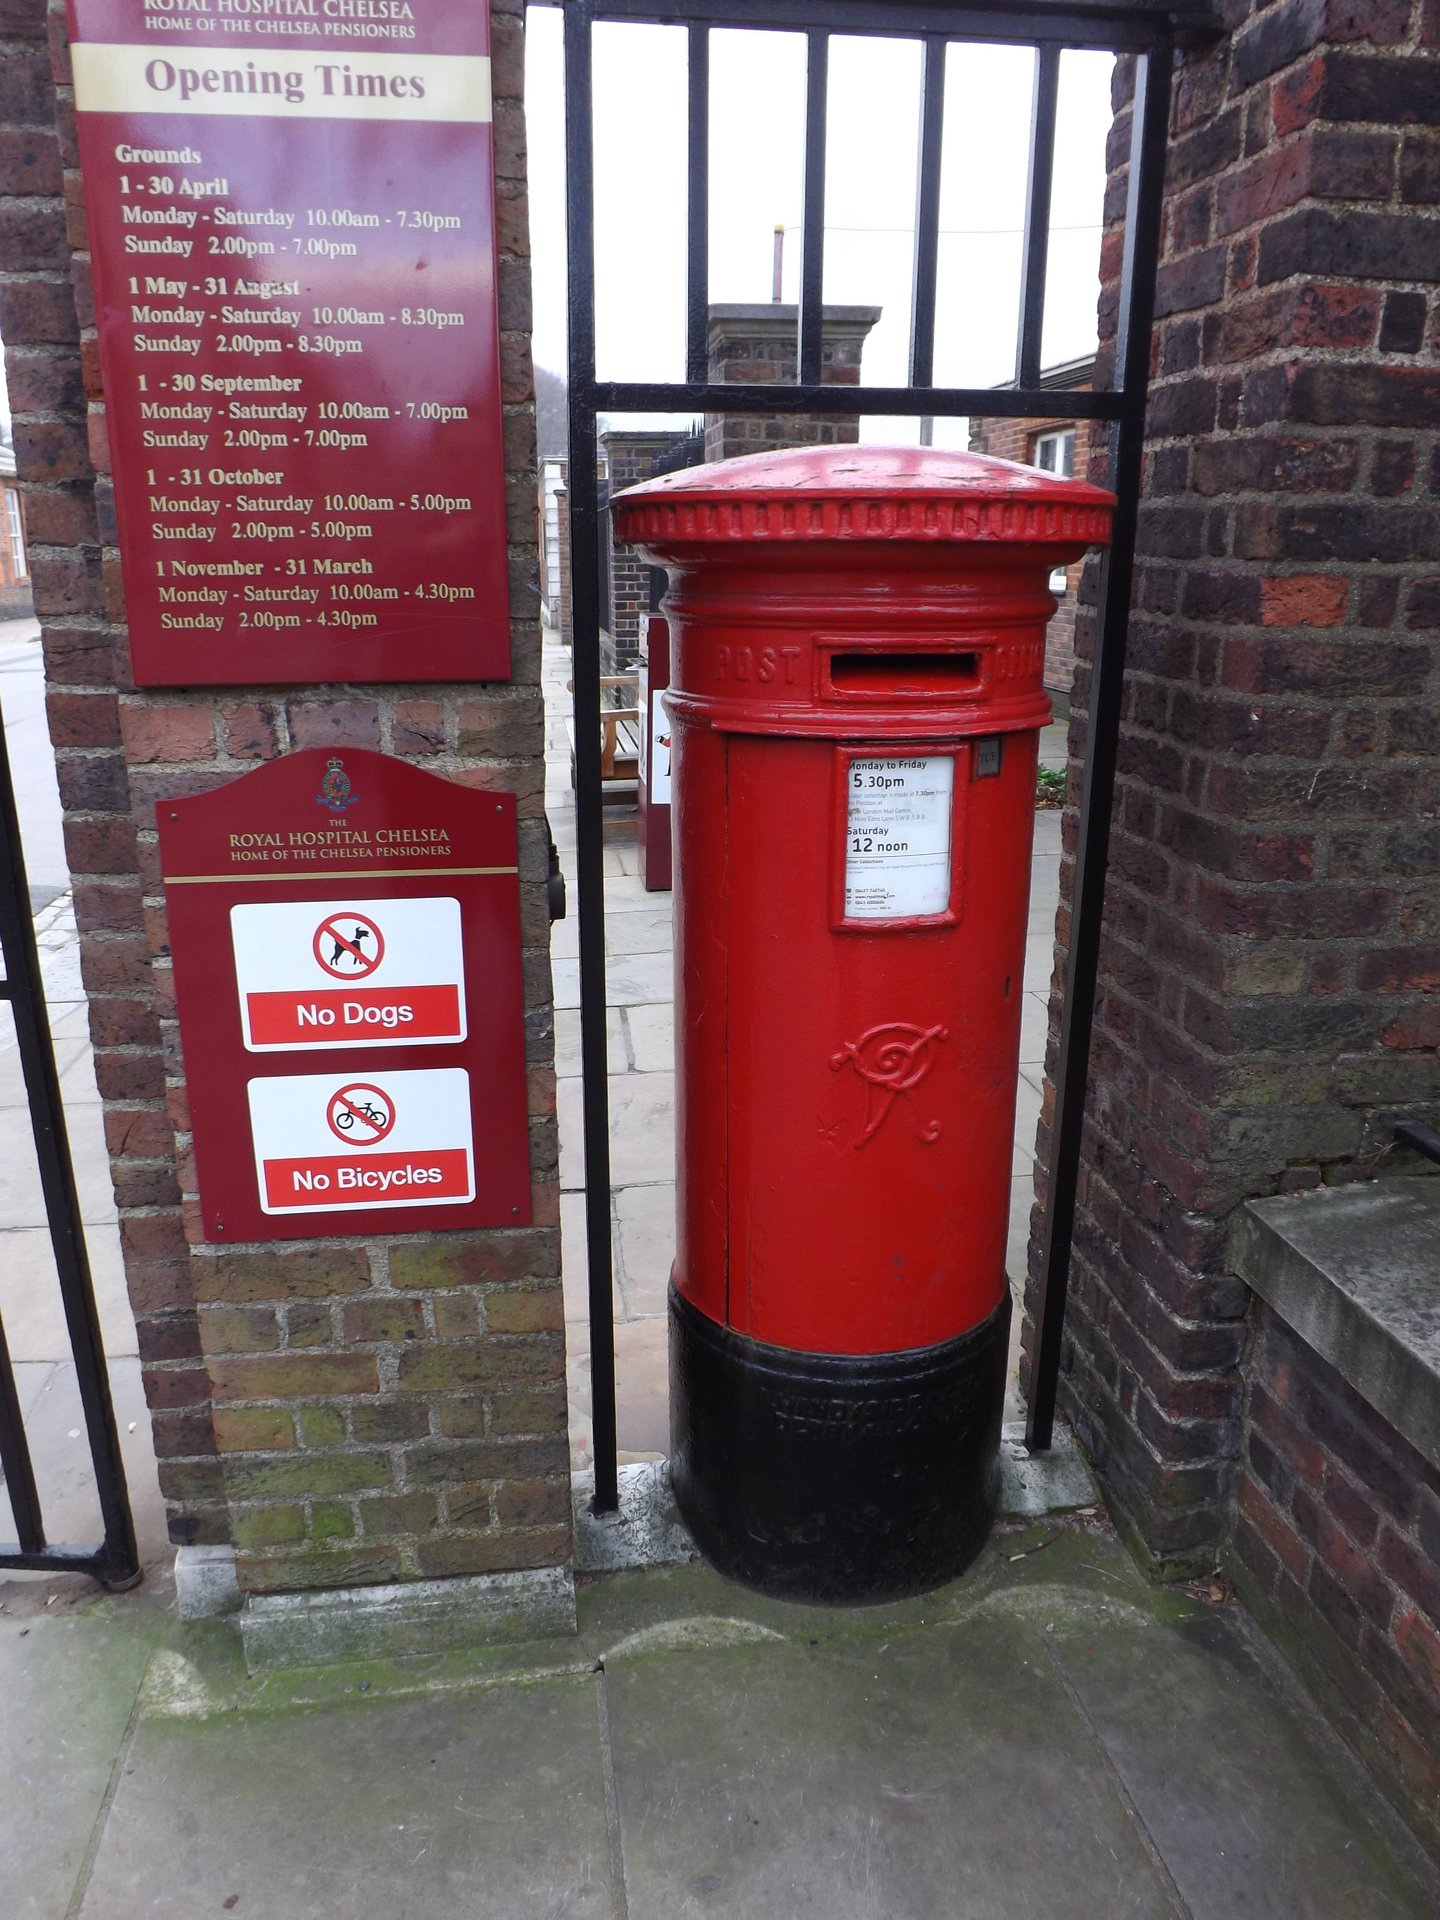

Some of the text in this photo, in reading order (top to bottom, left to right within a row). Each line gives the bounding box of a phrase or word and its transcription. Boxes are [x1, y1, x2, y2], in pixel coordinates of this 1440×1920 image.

[218, 0, 318, 16] HOSPITAL
[323, 0, 414, 19] CHELSEA
[145, 16, 416, 39] HOME OF THE CHELSEA PENSIONERS
[145, 59, 426, 103] Opening Times
[115, 144, 201, 165] Grounds
[119, 176, 130, 194] 1
[149, 176, 173, 195] 30
[179, 177, 229, 200] April
[122, 206, 197, 226] Monday
[214, 207, 295, 229] Saturday
[306, 209, 380, 227] 10.00am
[396, 211, 461, 232] 7.30pm
[125, 235, 193, 257] Sunday
[208, 236, 274, 258] 2.00pm
[294, 238, 357, 259] 7.00pm
[129, 276, 139, 294] 1
[145, 277, 188, 298] May
[205, 277, 226, 294] 31
[234, 278, 300, 299] August
[132, 305, 205, 327] Monday
[222, 306, 301, 328] Saturday
[312, 308, 385, 325] 10.00am
[401, 309, 465, 328] 8.30pm
[134, 335, 202, 356] Sunday
[216, 335, 282, 356] 2.00pm
[299, 336, 363, 356] 8.30pm
[138, 375, 148, 391] 1
[172, 375, 195, 392] 30
[201, 376, 302, 397] September
[141, 402, 212, 423] Monday
[229, 402, 308, 423] Saturday
[318, 402, 390, 419] 10.00am
[406, 403, 469, 422] 7.00pm
[143, 430, 209, 450] Sunday
[223, 430, 289, 450] 2.00pm
[304, 430, 368, 449] 7.00pm
[147, 469, 157, 485] 1
[180, 469, 202, 485] 31
[208, 468, 284, 485] October
[150, 497, 220, 515] Monday
[237, 496, 314, 515] Saturday
[324, 494, 394, 511] 10.00am
[410, 494, 472, 514] 5.00pm
[152, 523, 217, 542] Sunday
[231, 522, 294, 542] 2.00pm
[311, 522, 372, 541] 5.00pm
[156, 560, 166, 577] 1
[172, 560, 264, 576] November
[286, 559, 307, 575] 31
[313, 558, 373, 574] March
[159, 587, 228, 605] Monday
[244, 585, 319, 604] Saturday
[330, 584, 398, 600] 10.00am
[415, 584, 475, 602] 4.30pm
[161, 613, 224, 631] Sunday
[239, 611, 301, 630] 2.00pm
[317, 610, 378, 629] 4.30pm
[899, 760, 927, 769] Friday
[854, 773, 905, 789] 5.30pm
[329, 819, 347, 827] THE
[847, 827, 889, 835] Saturday
[229, 829, 450, 848] ROYAL HOSPITAL CHELSEA
[853, 838, 908, 852] 12 noon
[231, 846, 451, 861] HOME OF THE CHELSEA PENSIONERS
[296, 1002, 414, 1028] No Dogs
[293, 1164, 443, 1191] No Bicycles
